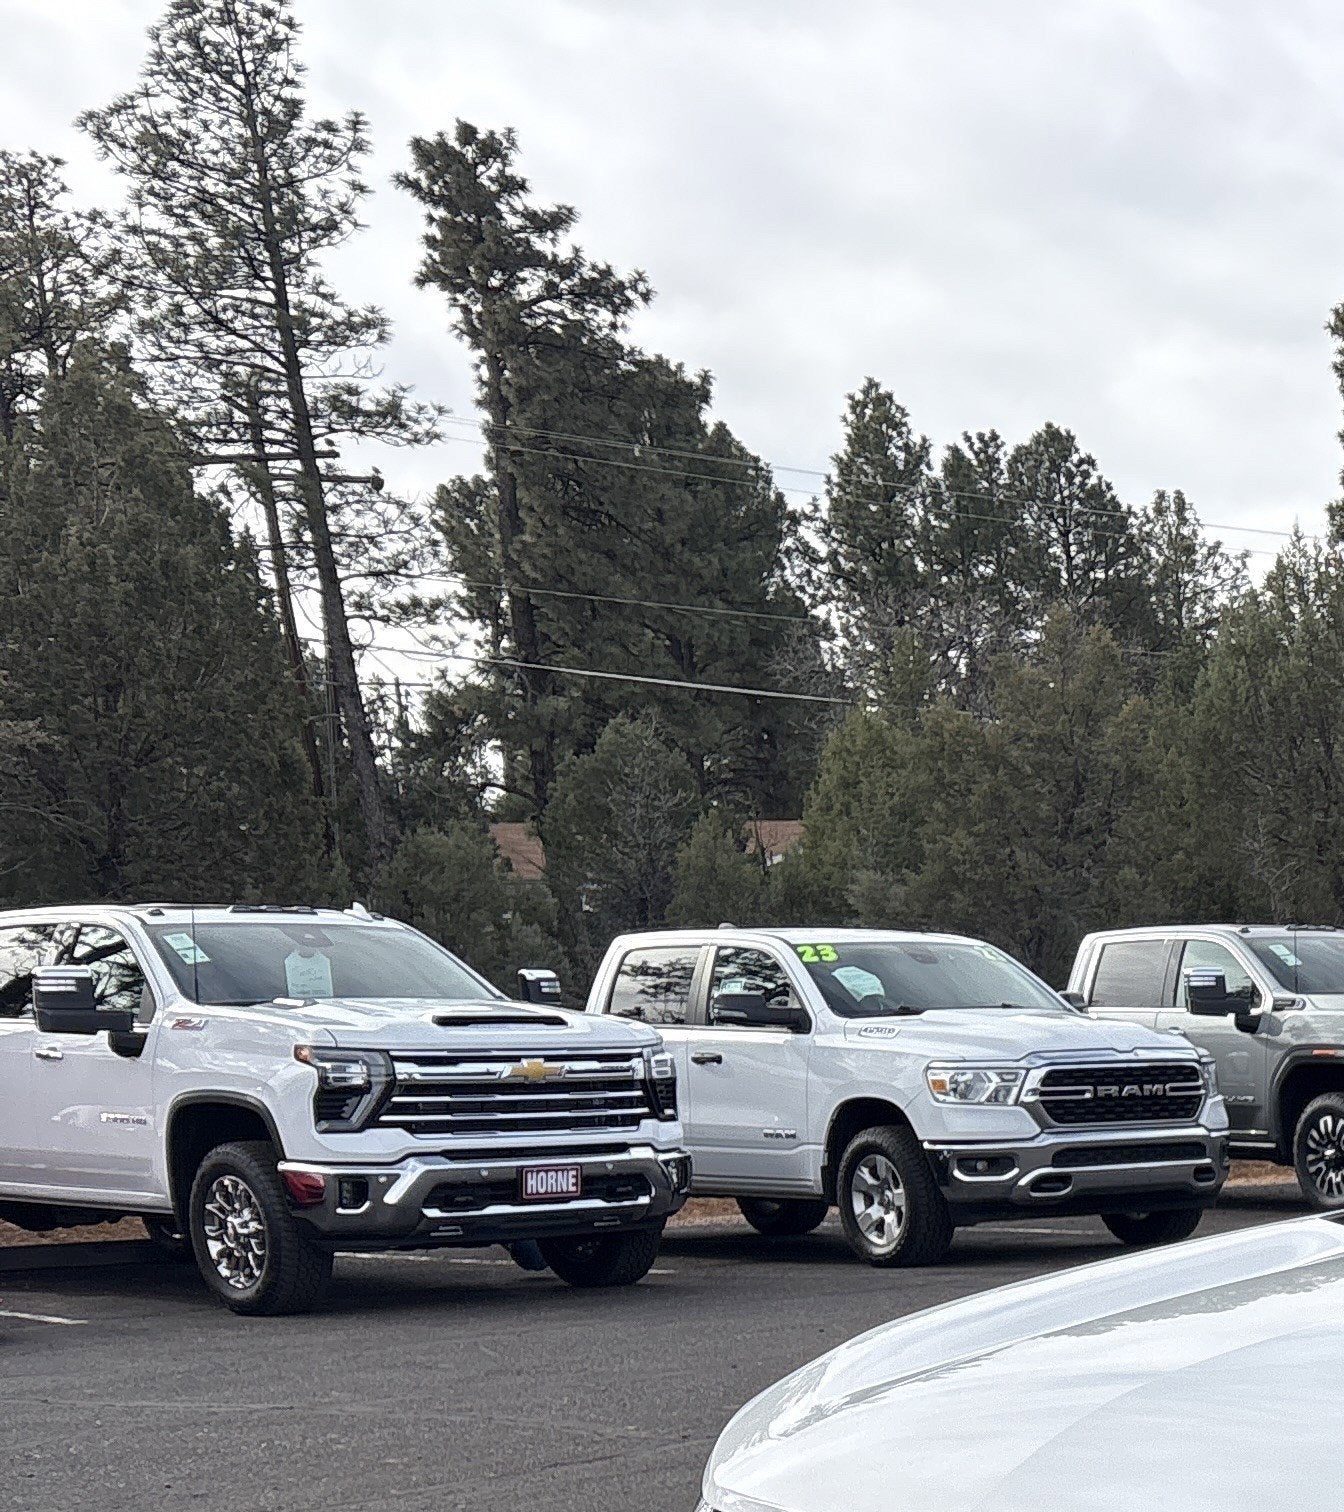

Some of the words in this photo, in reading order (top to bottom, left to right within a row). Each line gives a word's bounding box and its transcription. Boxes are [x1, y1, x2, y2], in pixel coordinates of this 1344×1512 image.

[796, 944, 839, 962] 23
[1097, 1083, 1165, 1097] RAM
[526, 1170, 577, 1195] HORNE
